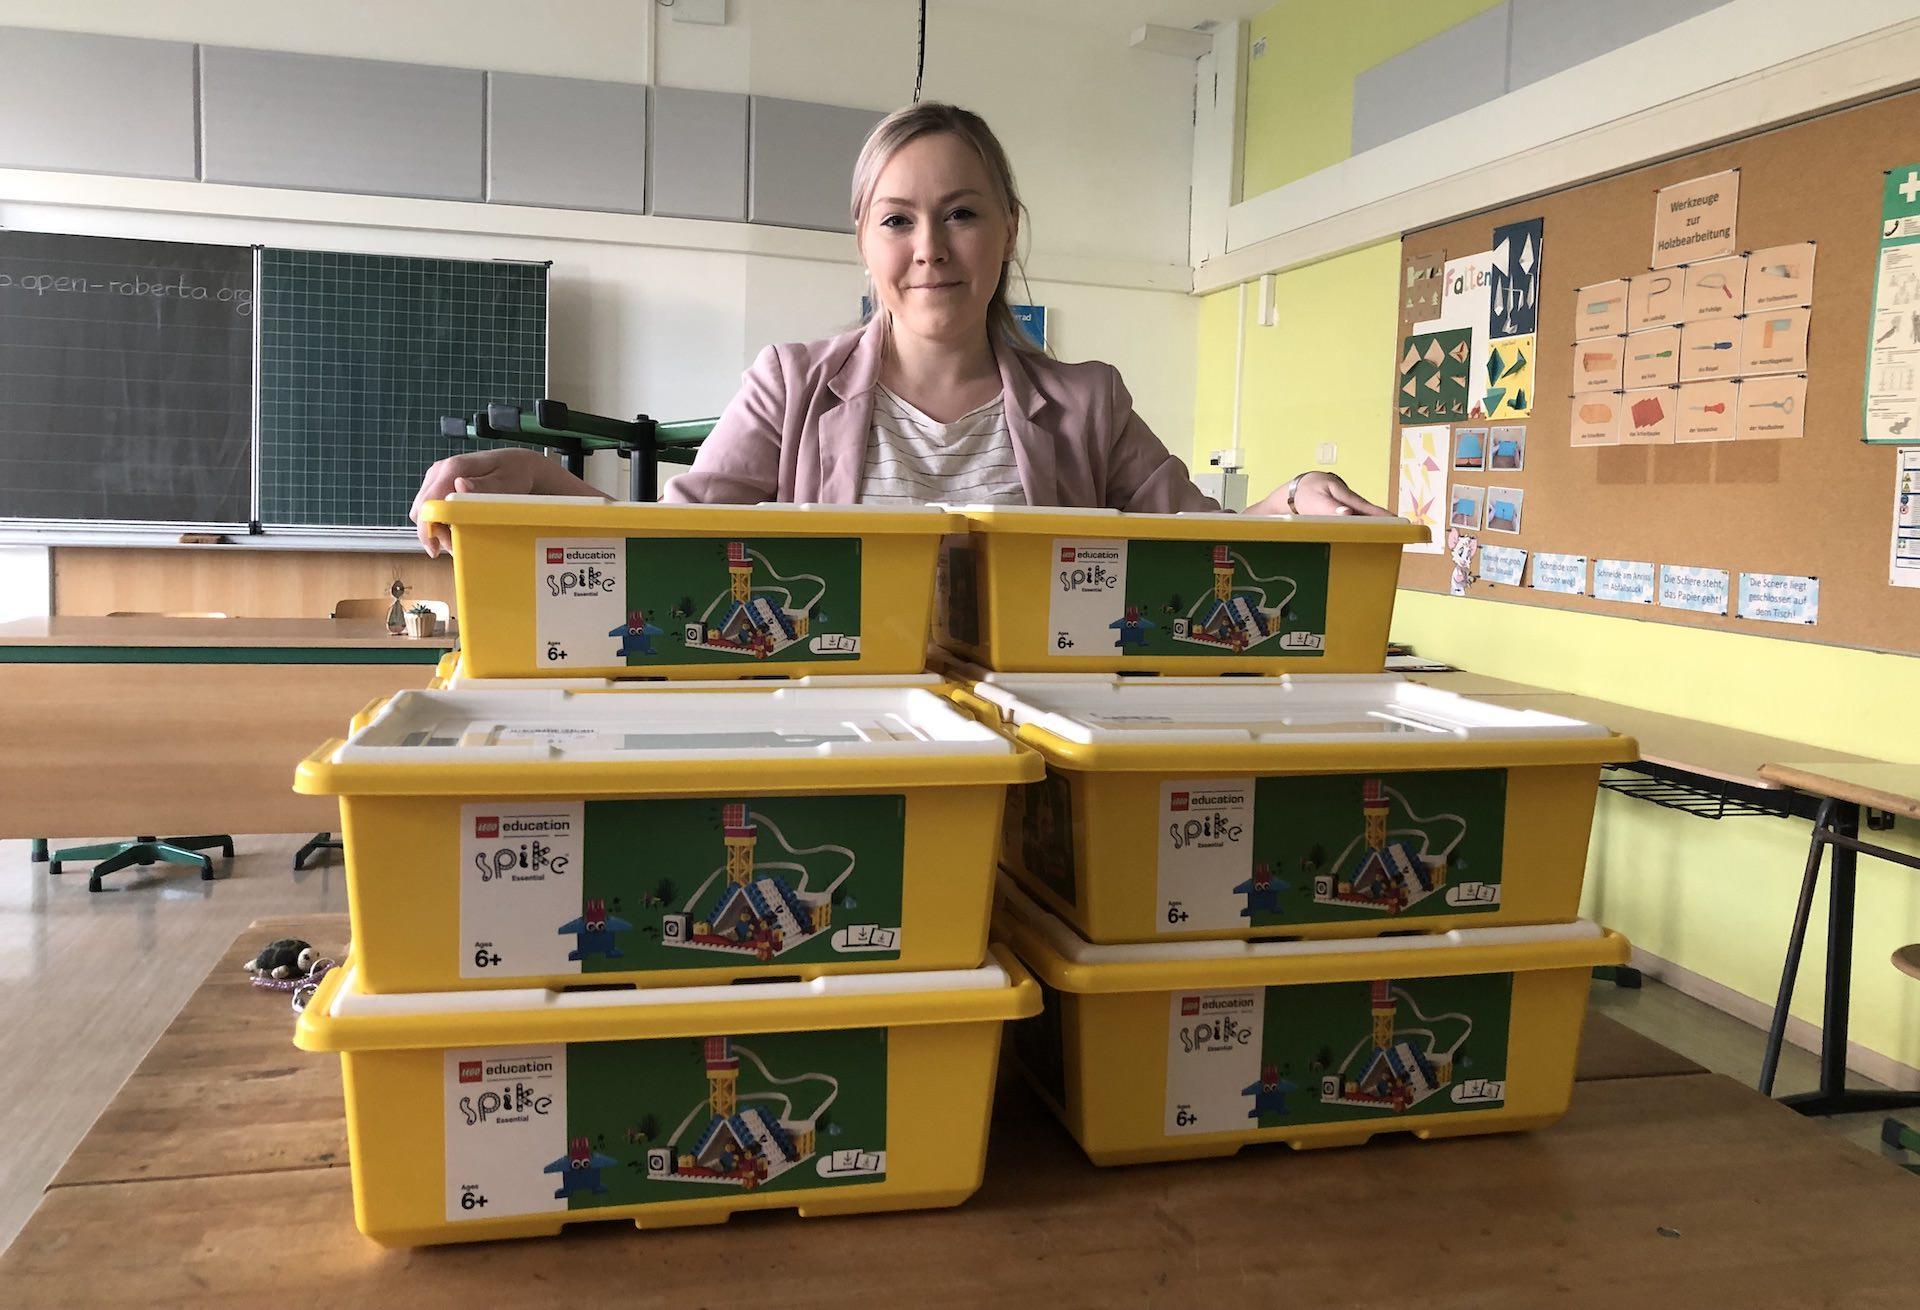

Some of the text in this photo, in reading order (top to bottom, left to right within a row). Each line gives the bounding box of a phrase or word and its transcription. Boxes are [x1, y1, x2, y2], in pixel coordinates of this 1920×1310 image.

[1670, 193, 1719, 213] Werkzeuge
[1686, 215, 1701, 227] zur
[1658, 227, 1731, 251] Holzbearbeitung
[1445, 264, 1492, 297] Falten
[566, 551, 616, 560] education
[1077, 551, 1118, 559] education
[1597, 568, 1621, 580] Schneide
[1664, 574, 1675, 584] Die
[1676, 576, 1701, 587] Schere
[1750, 578, 1807, 592] Die Schere liegt
[1664, 590, 1676, 599] das
[1677, 591, 1700, 602] Papier
[1748, 593, 1807, 605] geschlossen auf
[1755, 608, 1796, 618] dem Tisch!
[1058, 637, 1074, 649] 6+
[548, 647, 568, 660] 6+
[1191, 793, 1244, 805] education
[503, 820, 570, 832] education
[1168, 908, 1189, 924] 6+
[475, 949, 502, 967] 6+
[1202, 998, 1254, 1010] education
[486, 1061, 553, 1076] education
[496, 1115, 529, 1124] Essential
[1176, 1111, 1197, 1127] 6+
[461, 1192, 488, 1210] 6+
